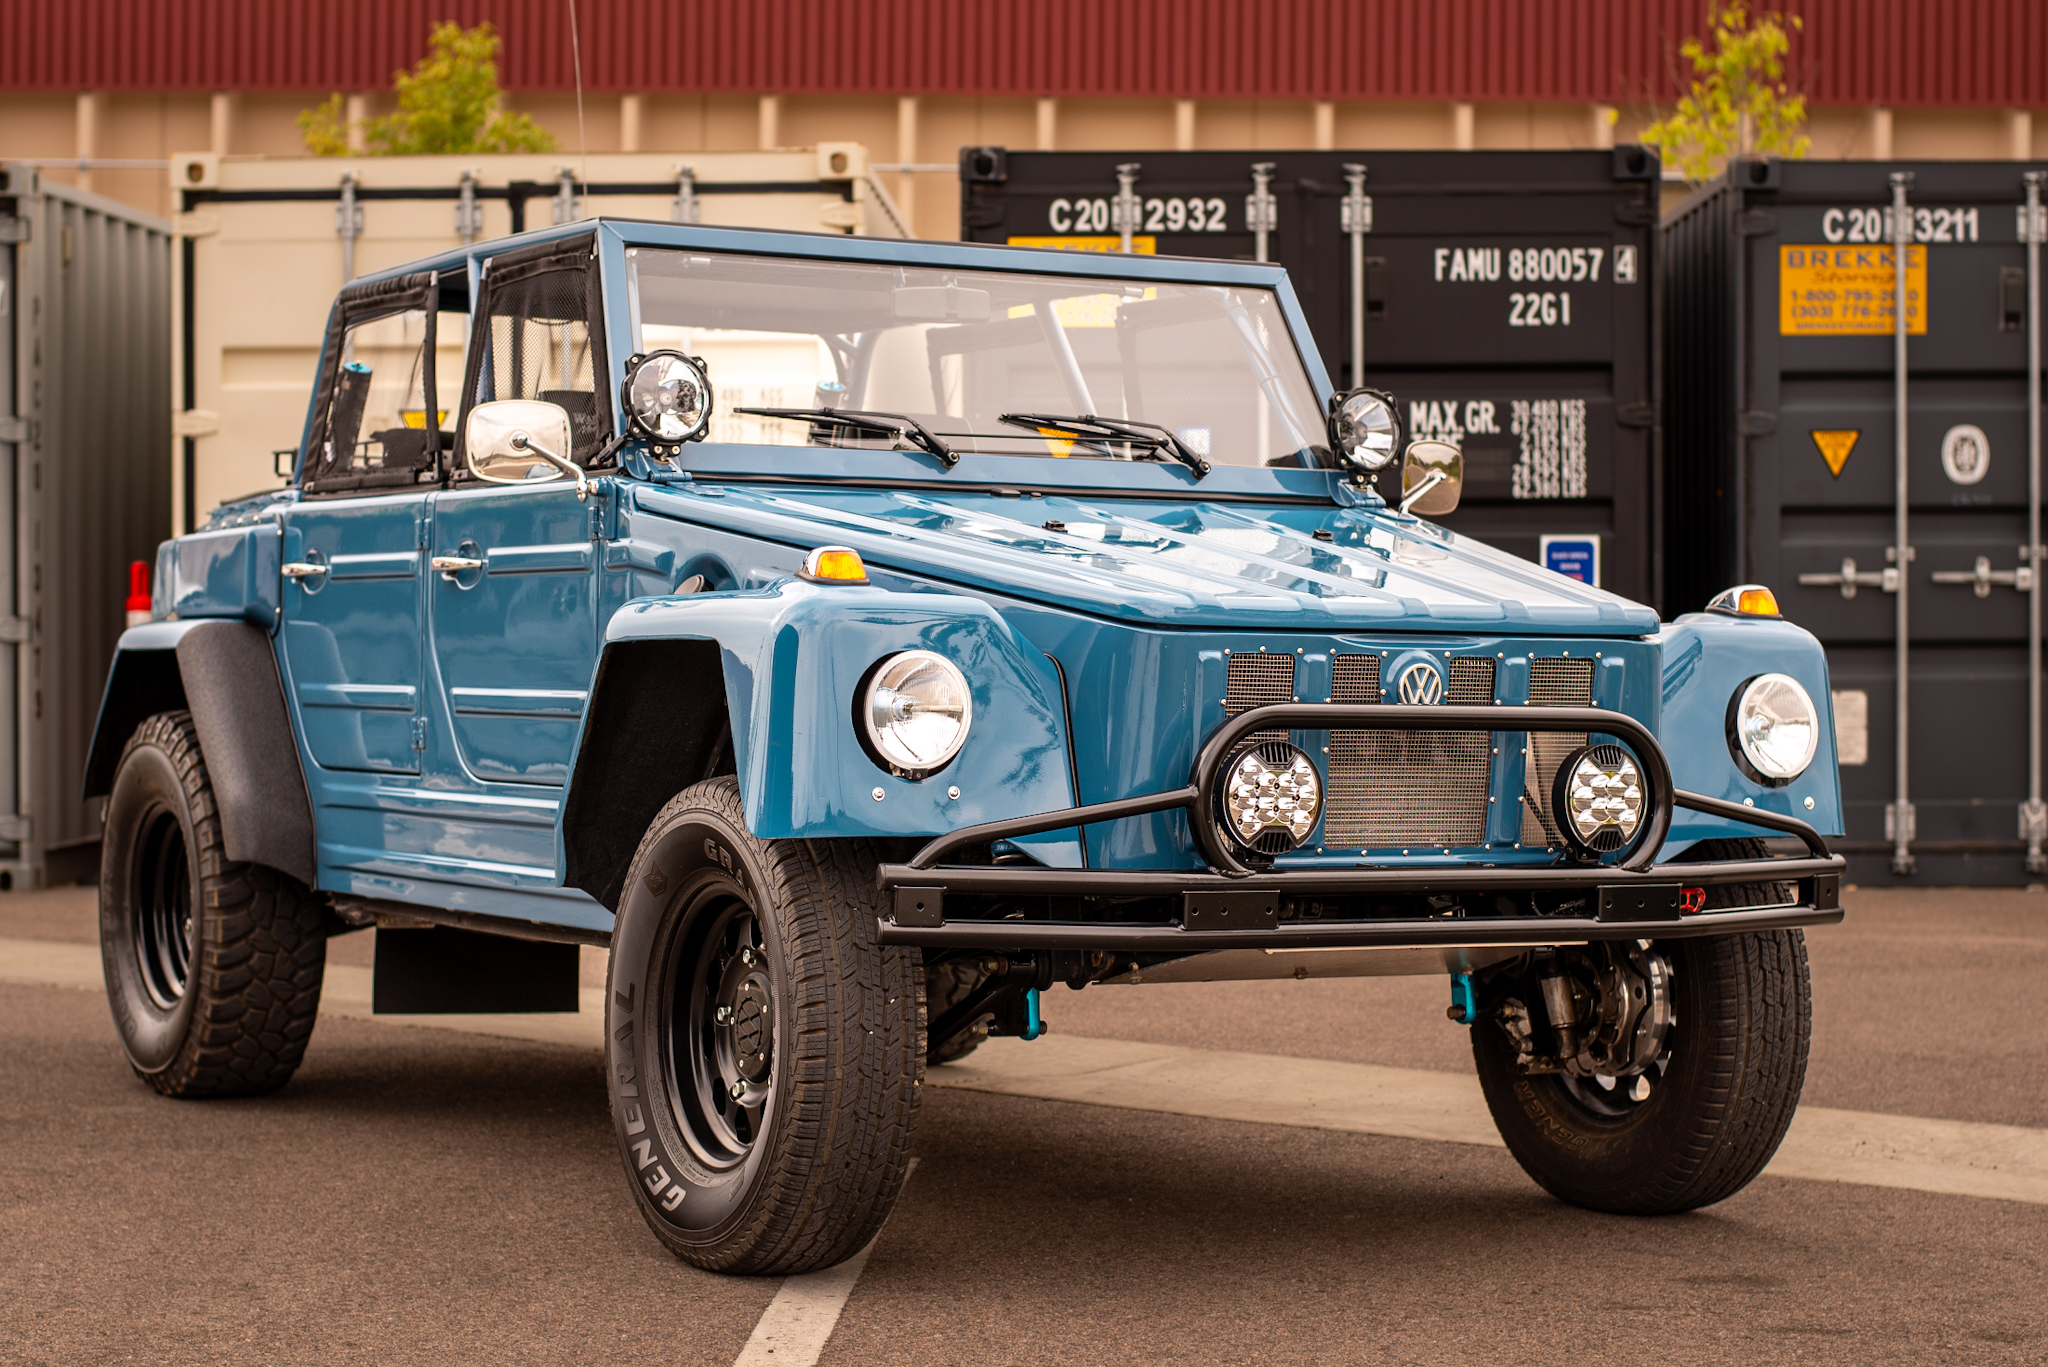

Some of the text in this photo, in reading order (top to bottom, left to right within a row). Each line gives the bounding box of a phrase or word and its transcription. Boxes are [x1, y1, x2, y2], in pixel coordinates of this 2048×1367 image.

[1434, 247, 1635, 283] FAMU 880057 4
[1787, 249, 1920, 268] BREKKE
[1508, 292, 1570, 326] 22G1
[615, 982, 688, 1212] GENERAL
